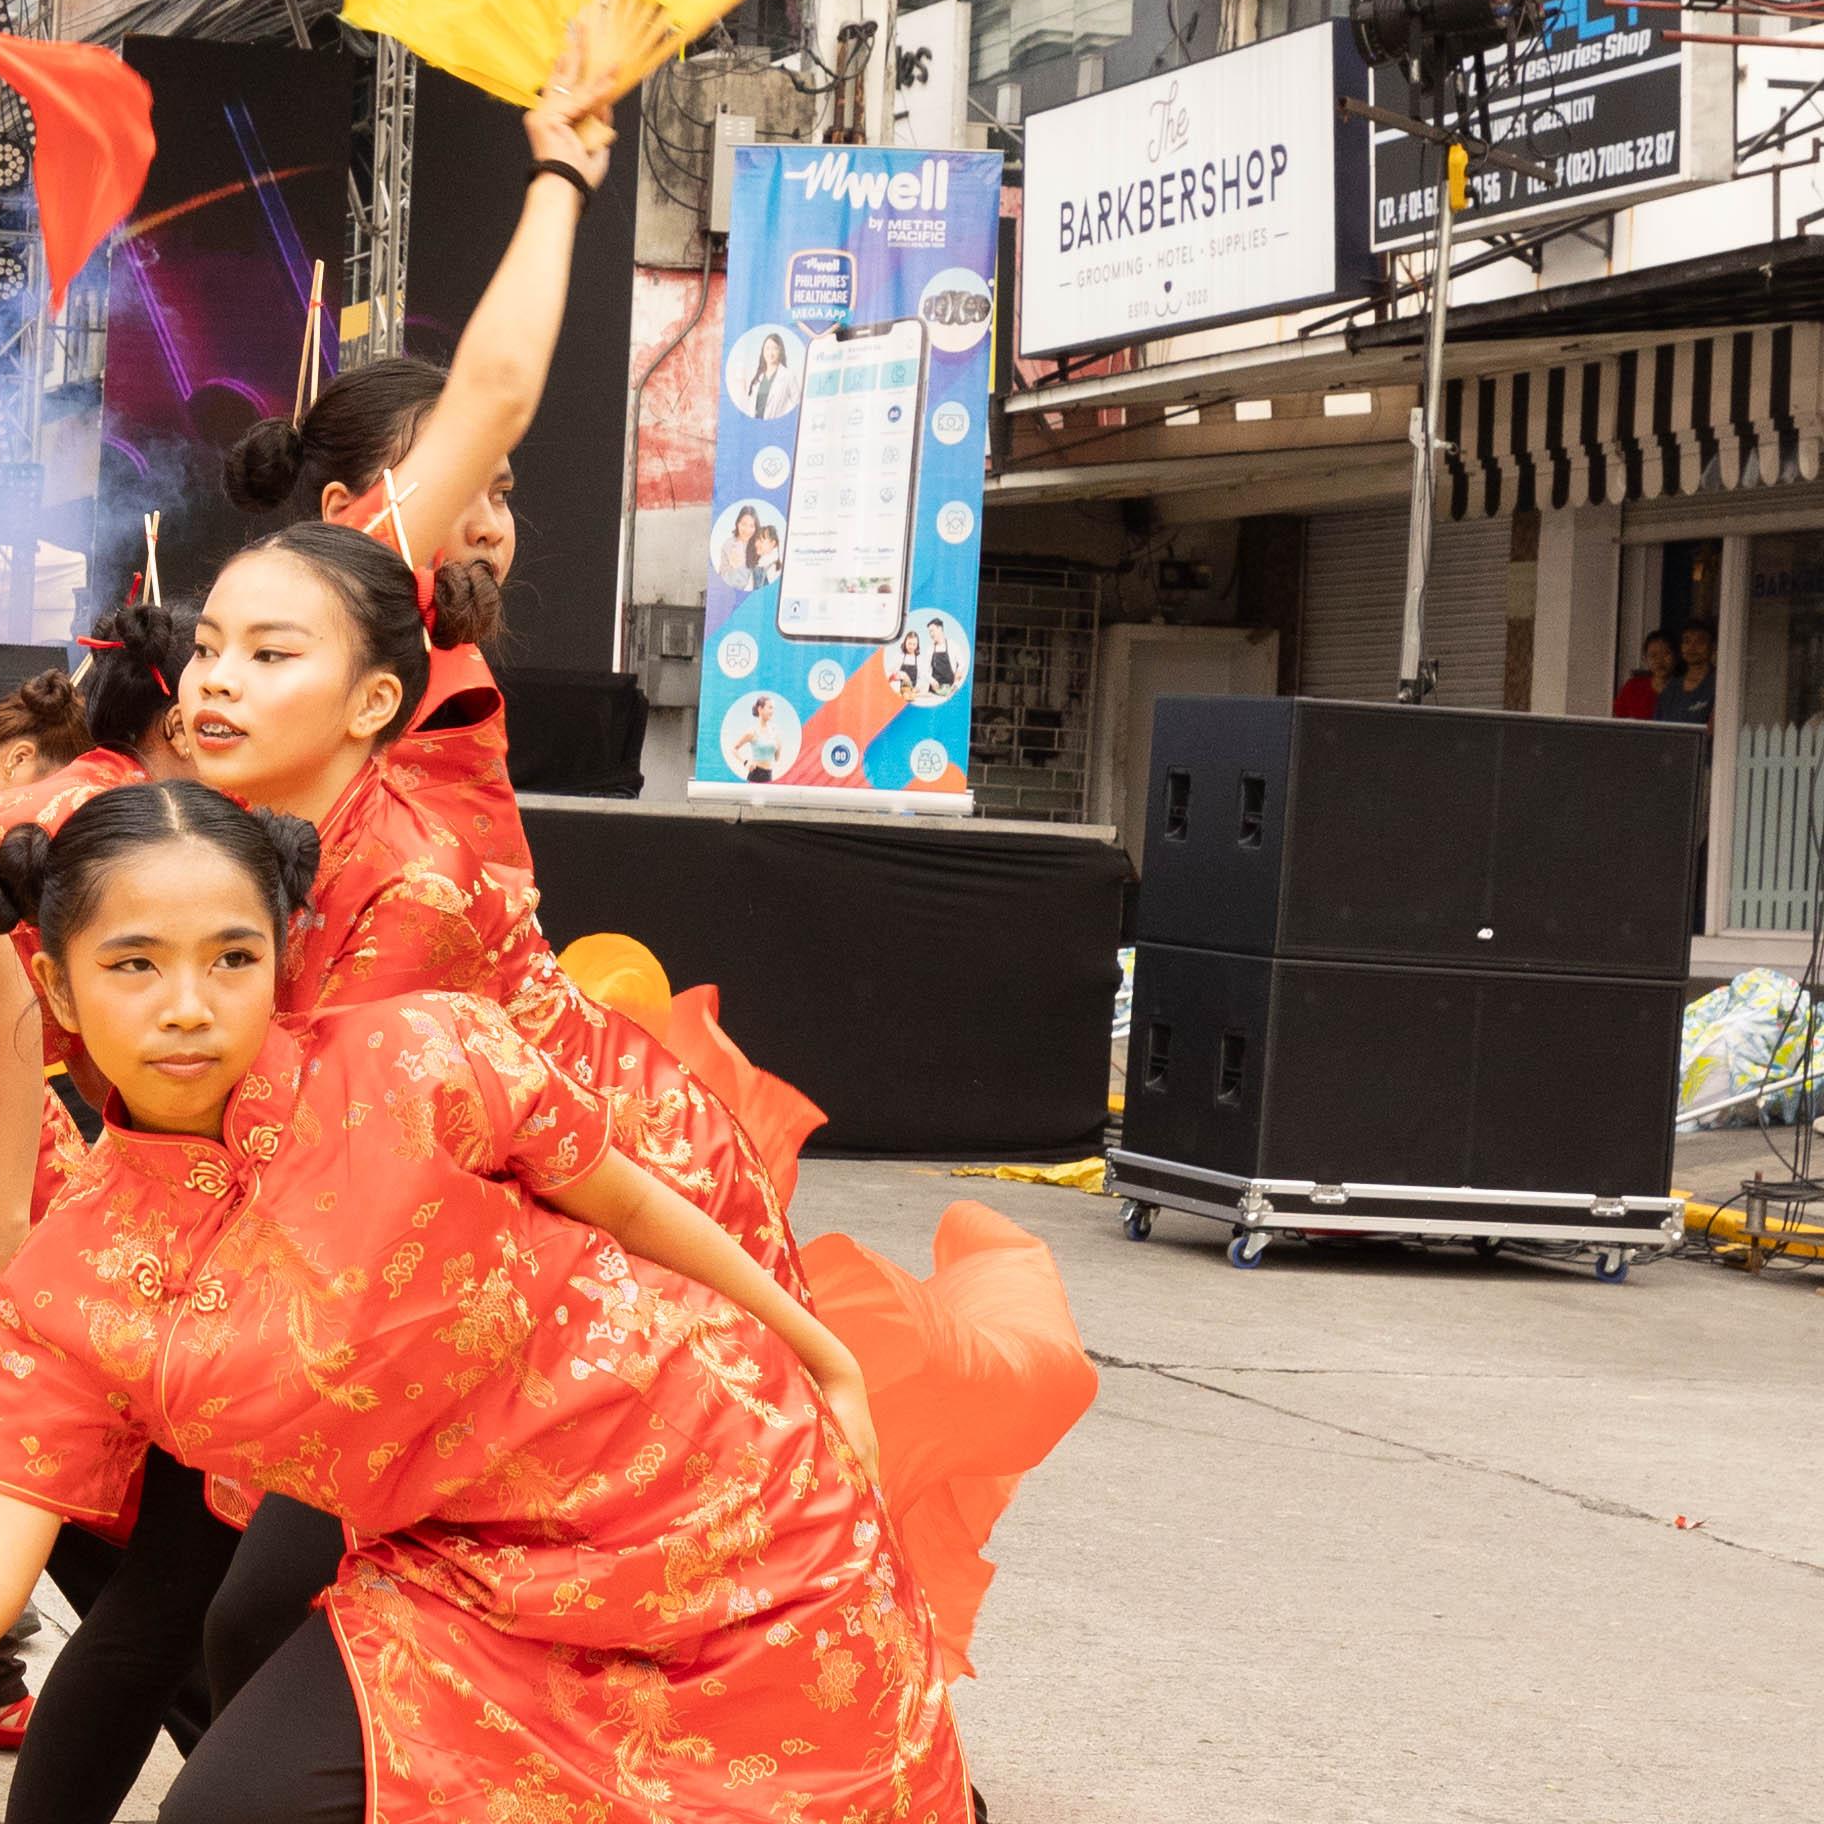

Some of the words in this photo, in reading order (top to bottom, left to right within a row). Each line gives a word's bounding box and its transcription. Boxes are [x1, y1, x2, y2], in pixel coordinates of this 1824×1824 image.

[1603, 28, 1652, 66] Shop
[1147, 79, 1189, 163] The
[1566, 148, 1596, 186] (02)
[1597, 140, 1634, 179] 7006
[1635, 135, 1654, 171] 22
[1655, 130, 1676, 165] 87
[1060, 143, 1288, 253] BARKBERSHOP
[868, 215, 885, 232] by
[887, 219, 946, 231] METRO
[887, 230, 946, 242] PACIFIC
[1077, 256, 1143, 287] GROOMING
[1157, 245, 1194, 269] HOTEL
[1210, 227, 1268, 258] SUPPLIES
[791, 307, 824, 320] MEGA
[824, 309, 847, 321] APP
[793, 289, 848, 304] HEALTHCARE
